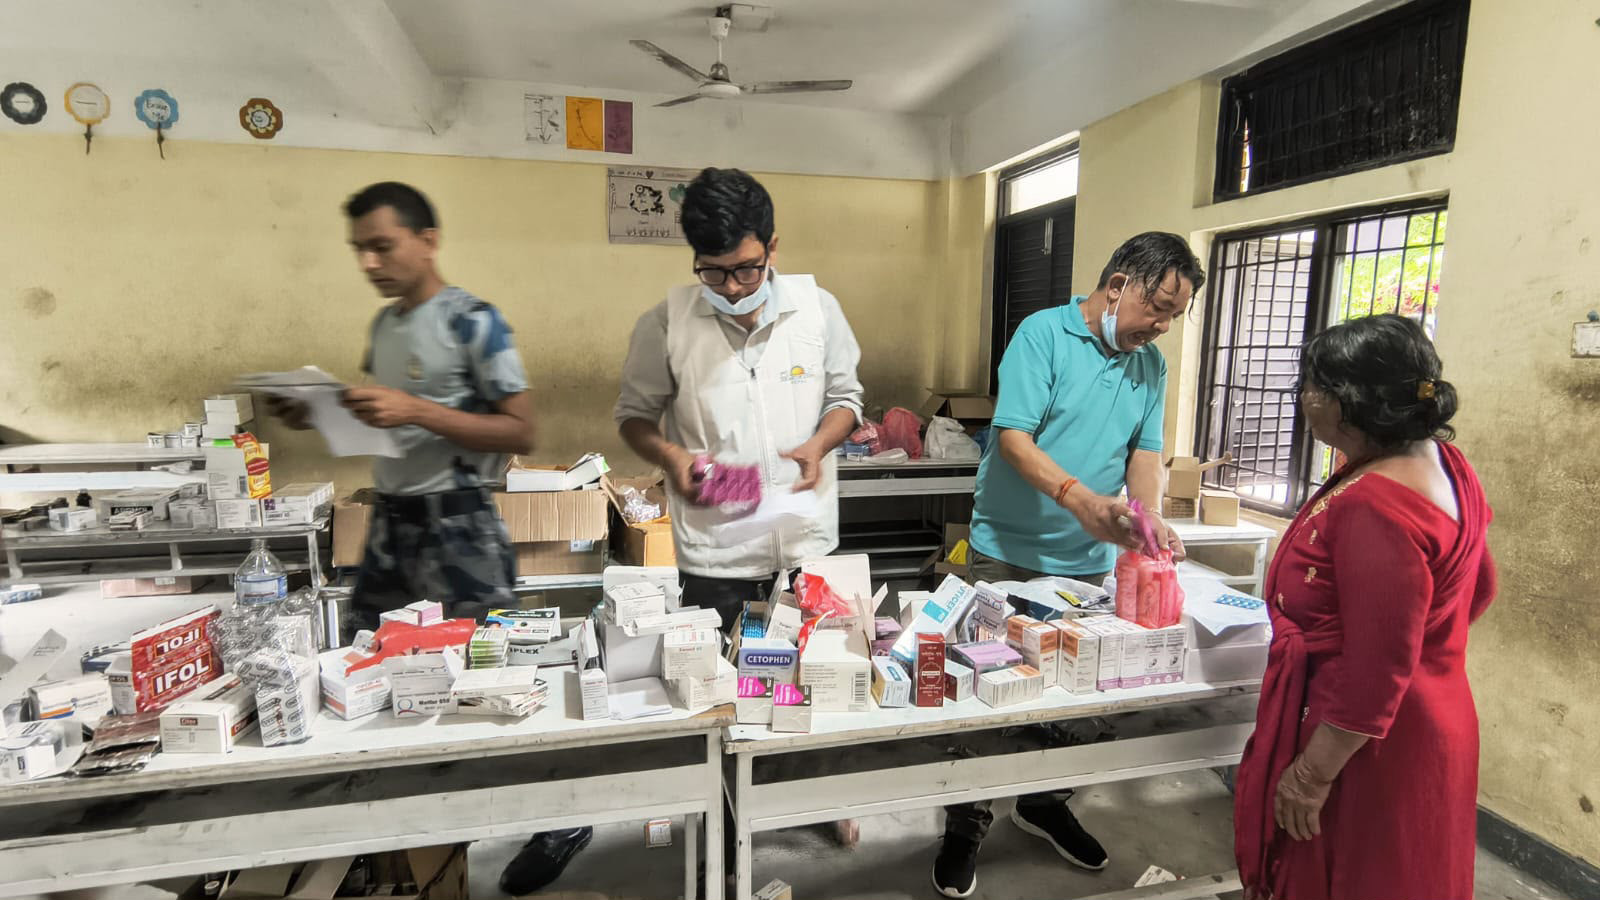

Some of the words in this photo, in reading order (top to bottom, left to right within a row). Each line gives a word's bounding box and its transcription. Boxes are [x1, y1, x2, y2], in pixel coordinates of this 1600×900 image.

[156, 628, 200, 653] IFOL
[747, 655, 791, 664] CETOPHEN
[155, 658, 210, 694] IFOL
